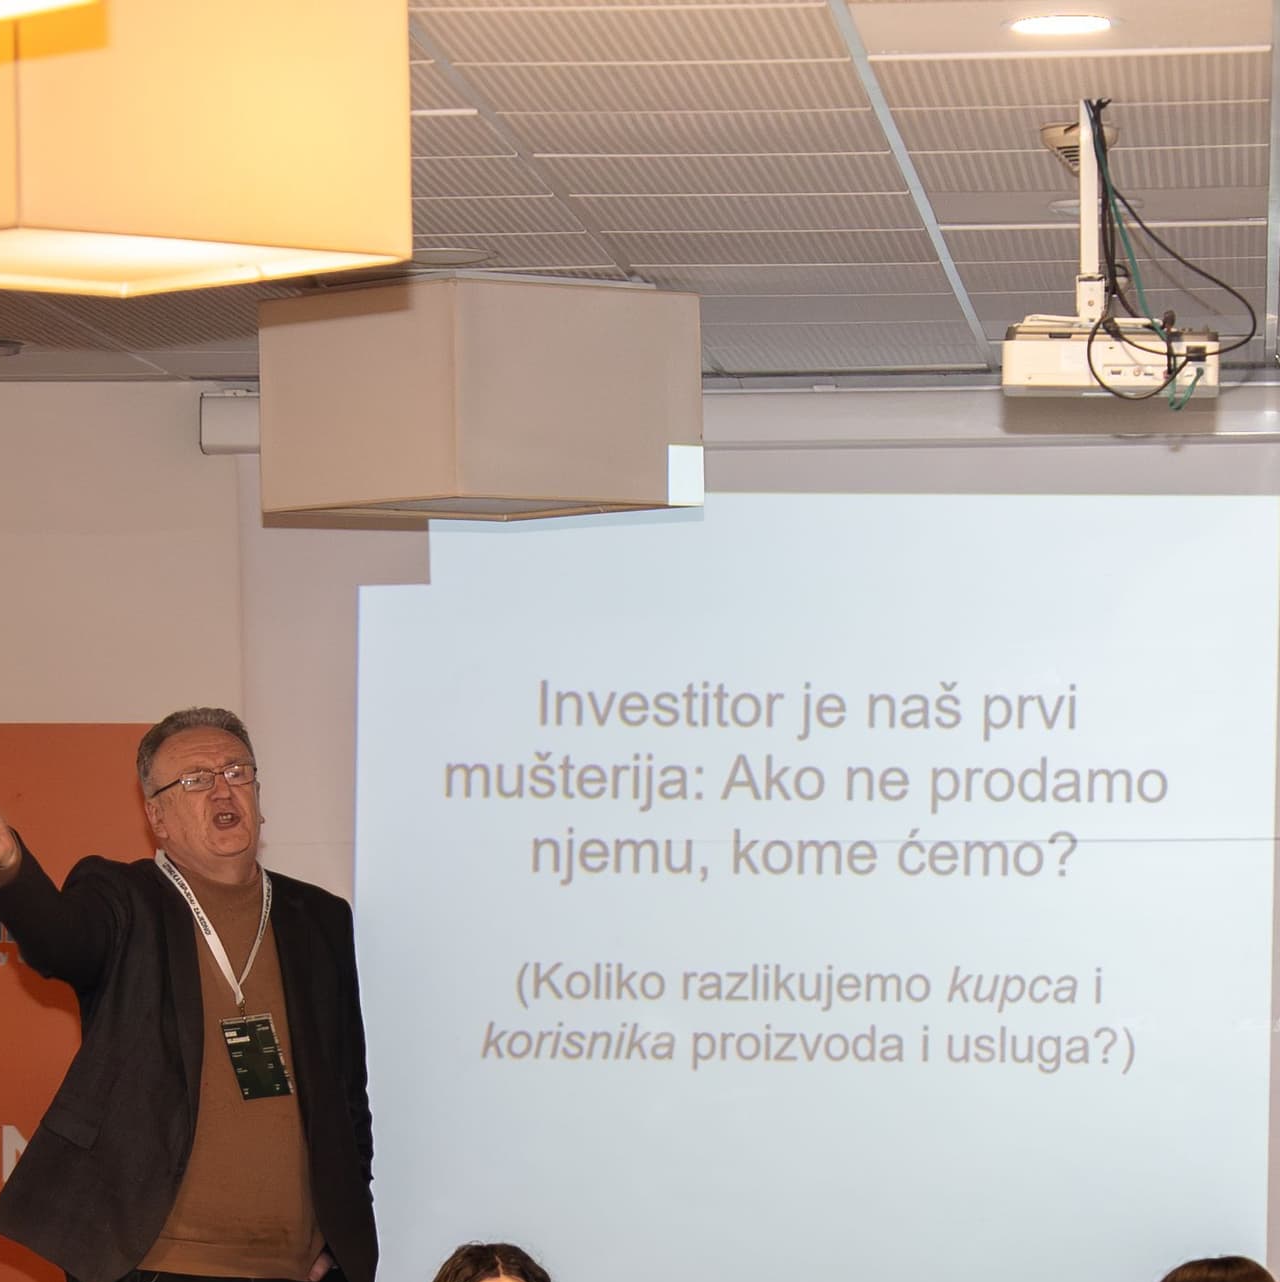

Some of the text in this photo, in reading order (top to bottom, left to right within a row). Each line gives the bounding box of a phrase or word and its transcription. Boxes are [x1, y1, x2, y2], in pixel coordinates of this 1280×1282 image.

[539, 680, 1075, 741] Investitor je naš prvi
[445, 752, 1167, 814] mušterija: Ako ne prodamo
[532, 827, 1078, 886] njemu, kome ćemo?
[516, 962, 1101, 1012] (Koliko razlikujemo kupca i
[481, 1022, 1134, 1074] korisnika proizvoda i usluga?)
